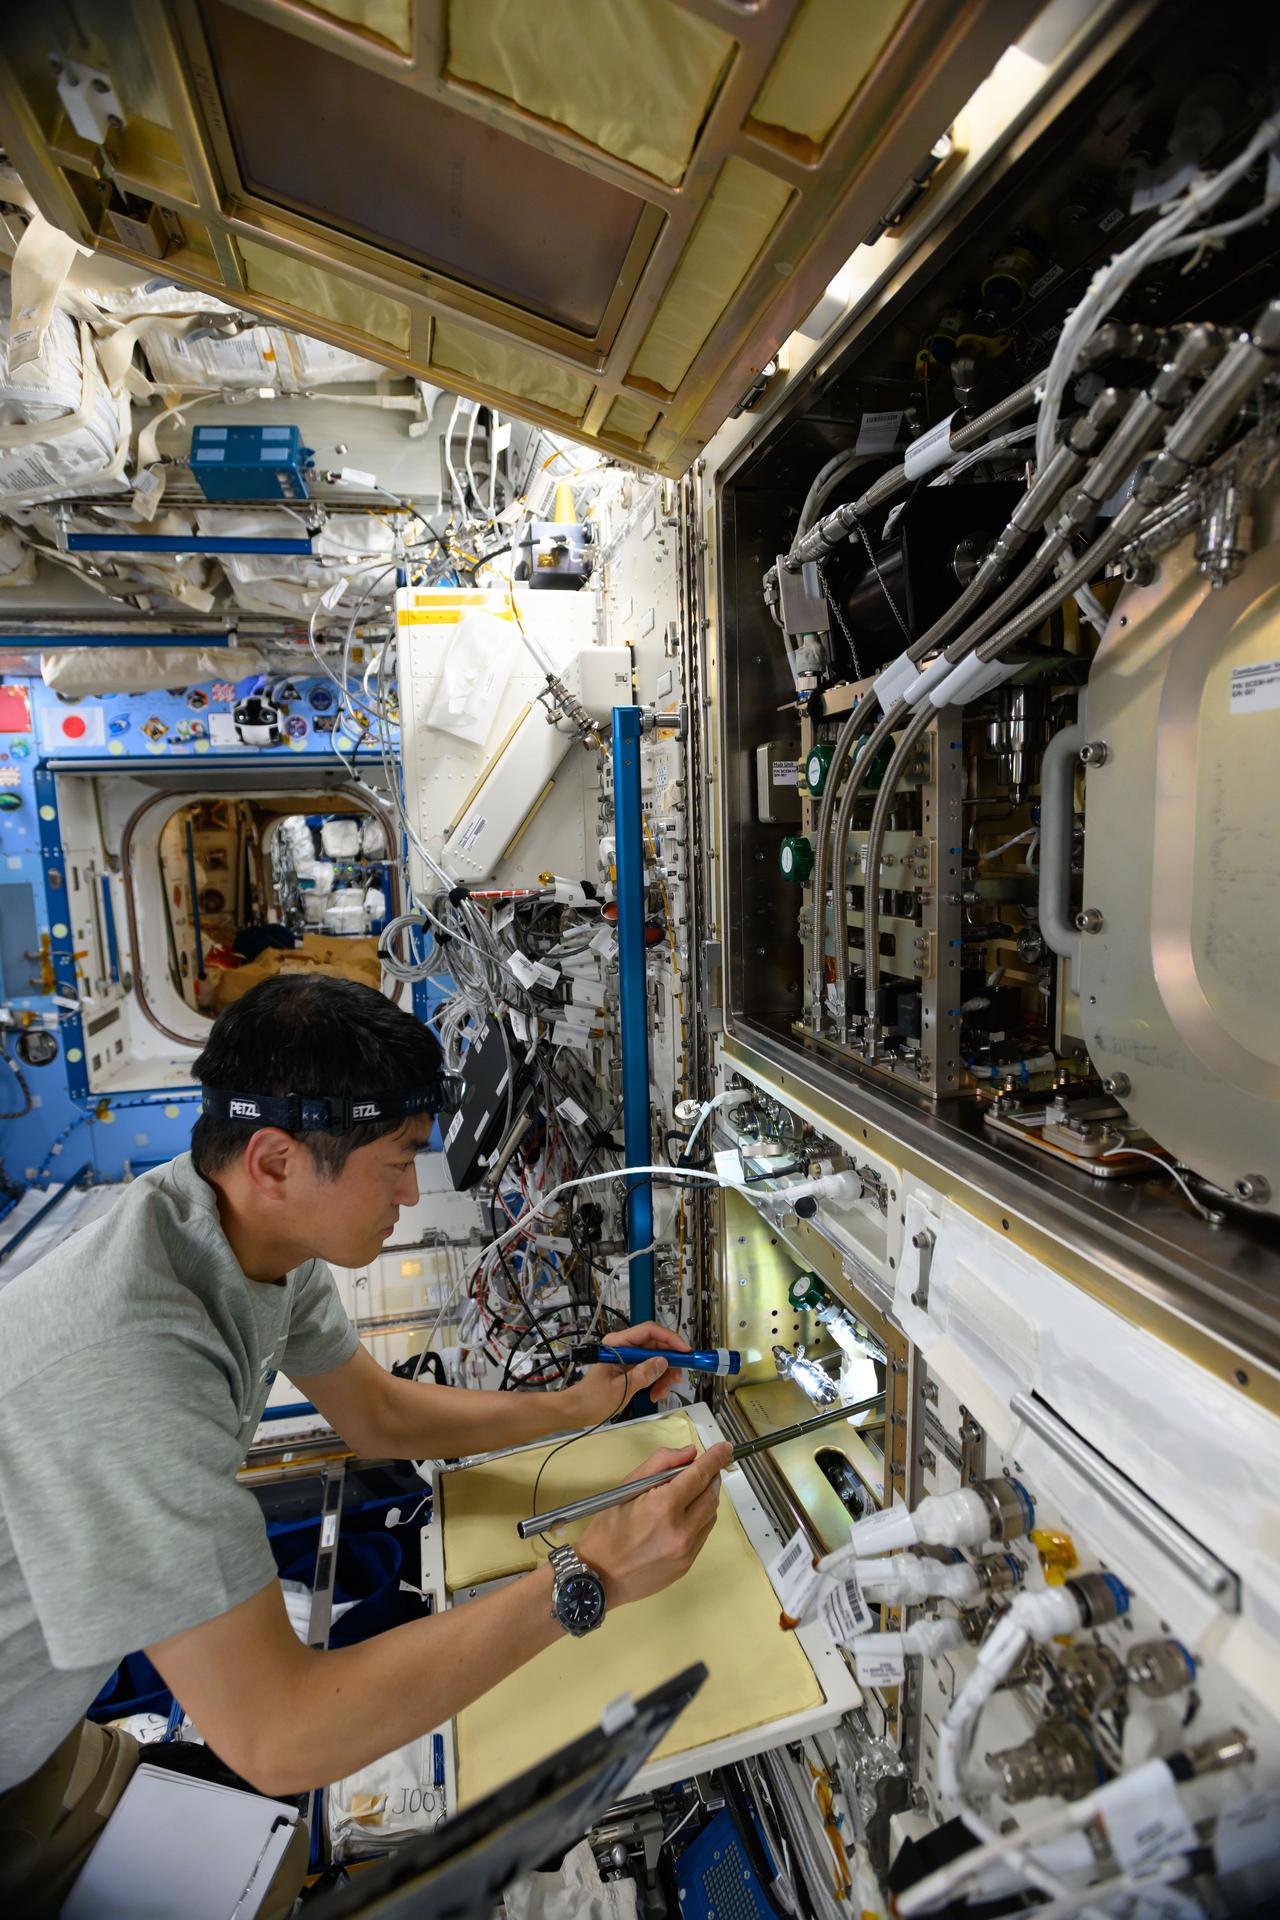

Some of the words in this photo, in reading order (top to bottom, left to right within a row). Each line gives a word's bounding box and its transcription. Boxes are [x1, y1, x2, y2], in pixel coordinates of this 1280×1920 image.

[1044, 267, 1059, 283] OUT
[229, 1100, 262, 1118] PETZL
[352, 1103, 382, 1118] ETZL
